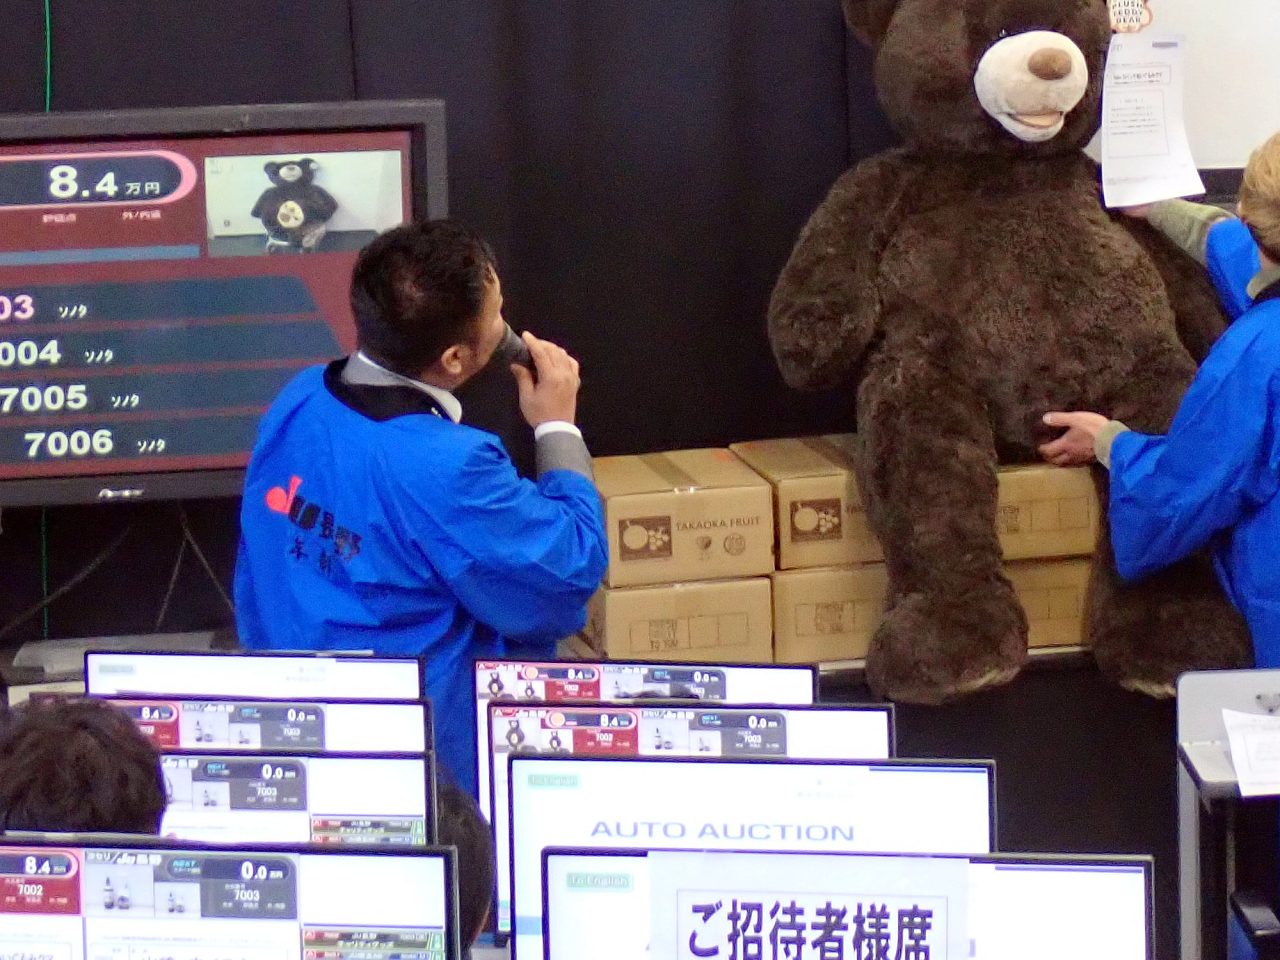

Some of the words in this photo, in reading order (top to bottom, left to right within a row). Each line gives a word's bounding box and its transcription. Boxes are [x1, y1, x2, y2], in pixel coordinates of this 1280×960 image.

[50, 165, 118, 199] 8.4
[125, 181, 161, 195] 万円
[0, 384, 88, 412] 7005
[24, 429, 114, 457] 7006
[676, 519, 728, 531] TAKAOKA
[729, 516, 760, 529] FRUIT
[590, 821, 687, 839] AUTO
[697, 822, 855, 842] AUCTION
[25, 855, 51, 875] 8.4
[241, 861, 268, 880] 0.0
[19, 884, 44, 896] 7002
[234, 890, 260, 902] 7003
[688, 897, 934, 960] ご招待者様席
